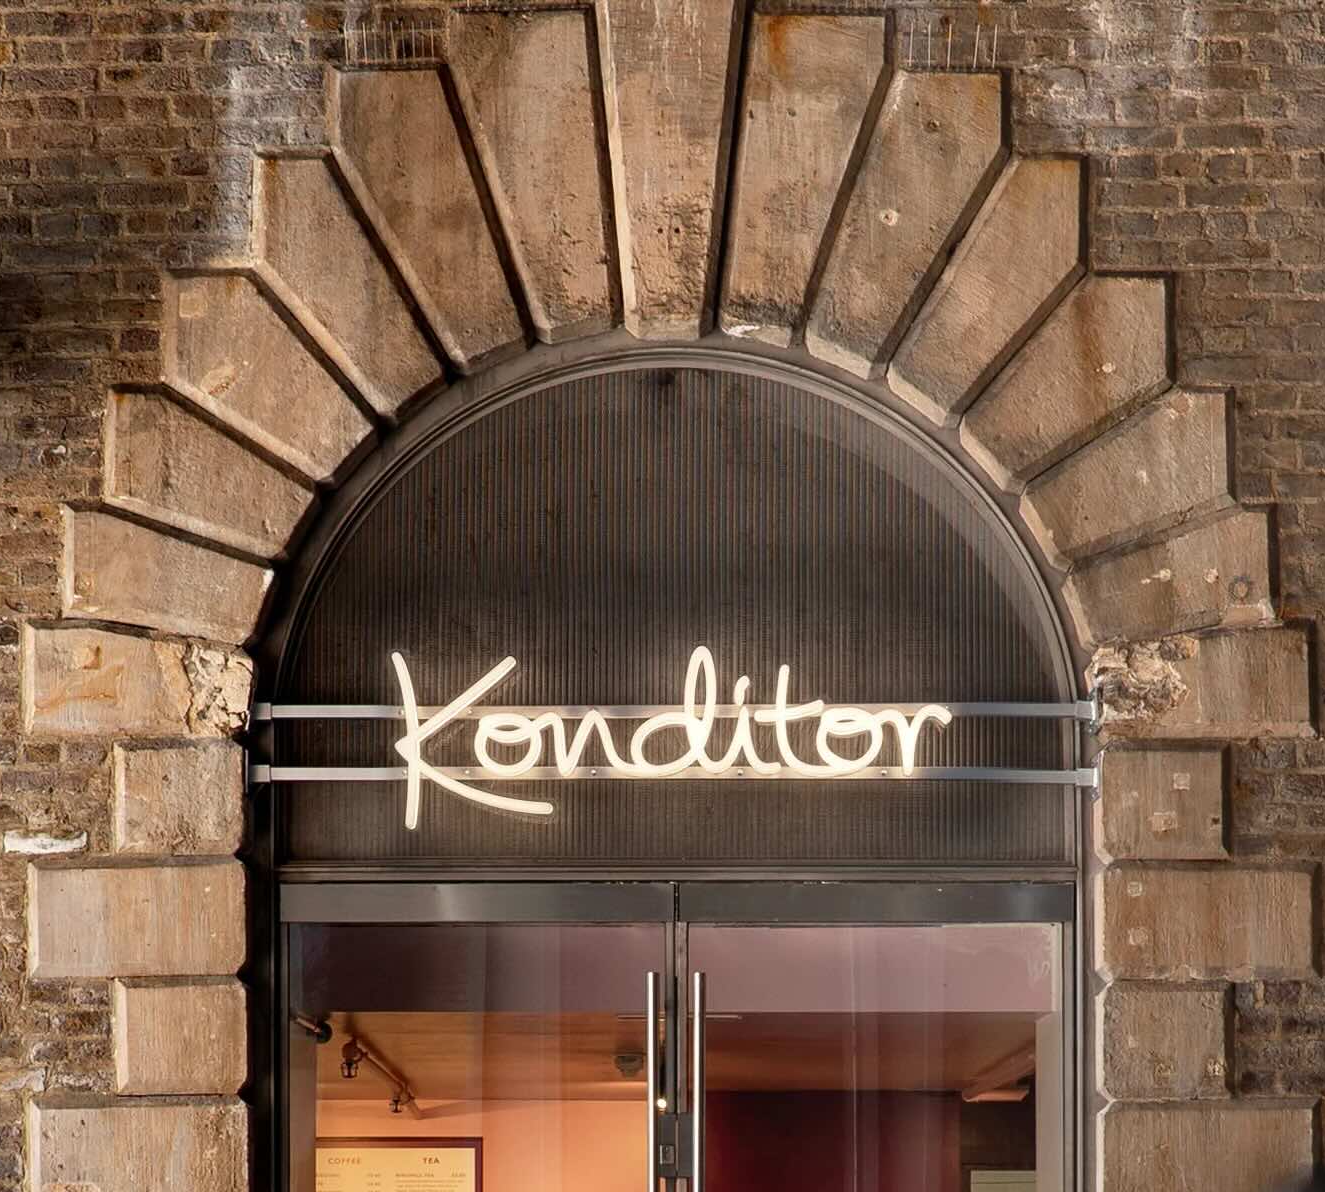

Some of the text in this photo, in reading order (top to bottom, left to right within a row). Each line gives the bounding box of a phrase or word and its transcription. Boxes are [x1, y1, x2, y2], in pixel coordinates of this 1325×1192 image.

[391, 645, 952, 830] Konditor
[327, 1157, 361, 1166] COFFEE
[422, 1157, 440, 1165] TEA
